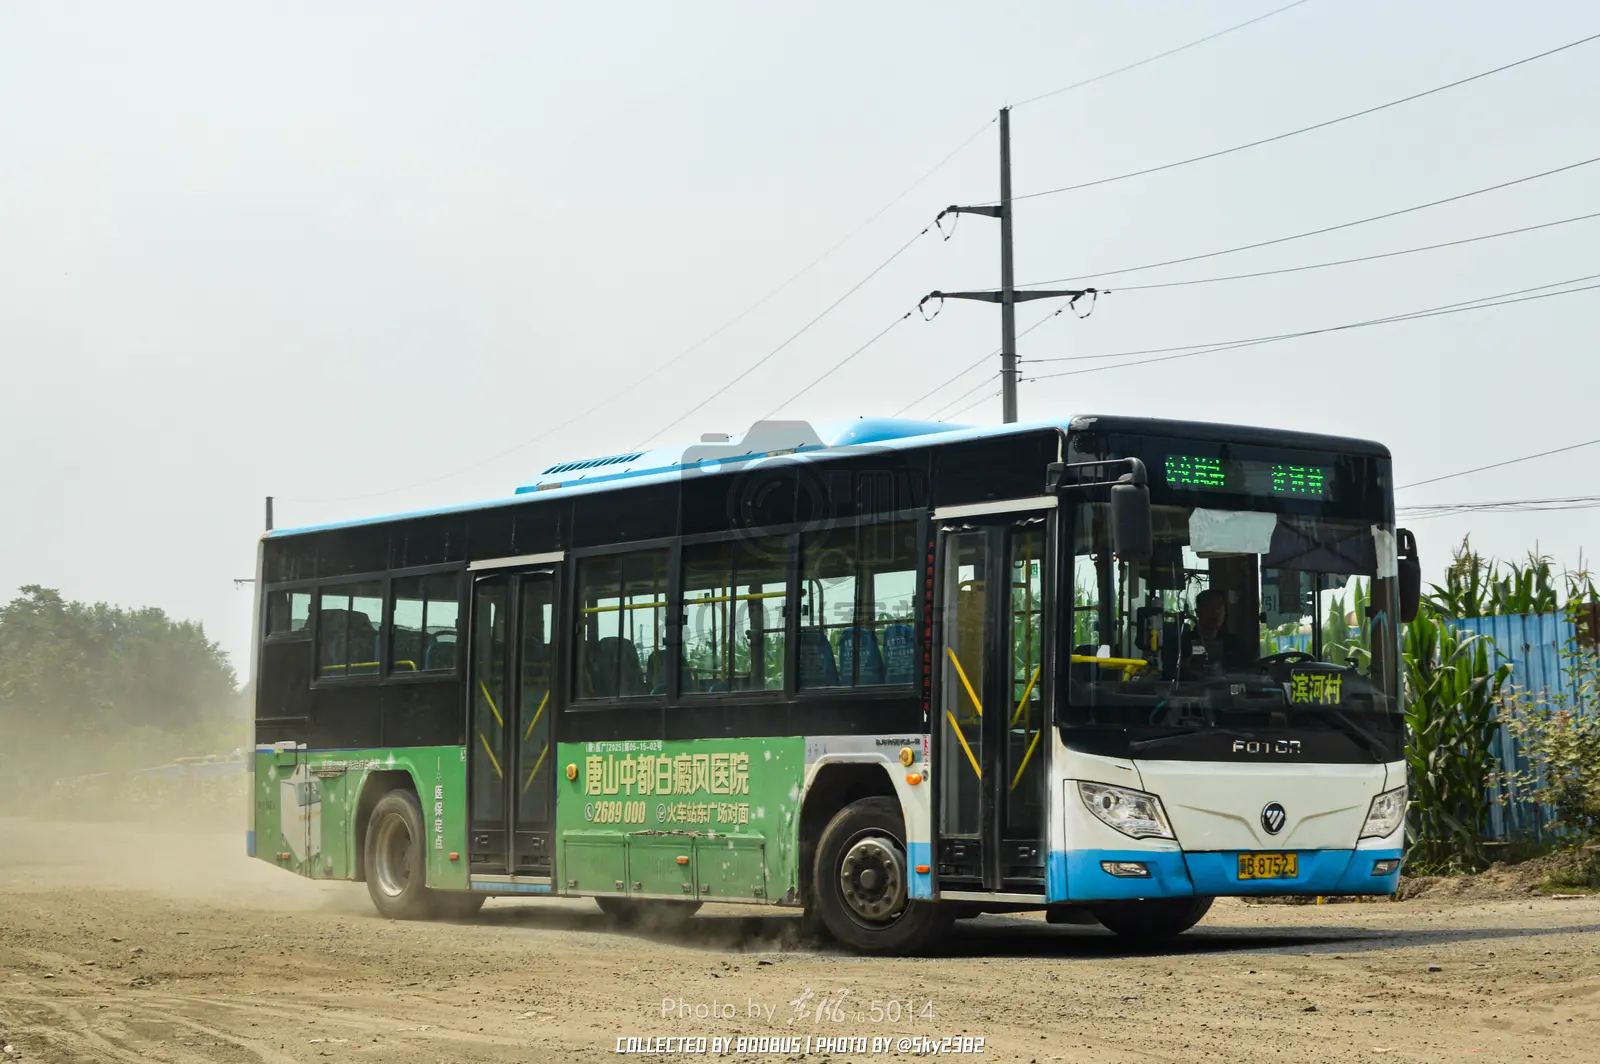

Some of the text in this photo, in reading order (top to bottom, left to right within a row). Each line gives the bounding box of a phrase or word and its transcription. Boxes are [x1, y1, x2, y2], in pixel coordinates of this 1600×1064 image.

[1291, 673, 1343, 705] 滨河村
[584, 752, 750, 796] 唐山中都白癜风医院
[593, 800, 647, 824] 2689 000
[667, 802, 750, 825] 火车站东广场对面
